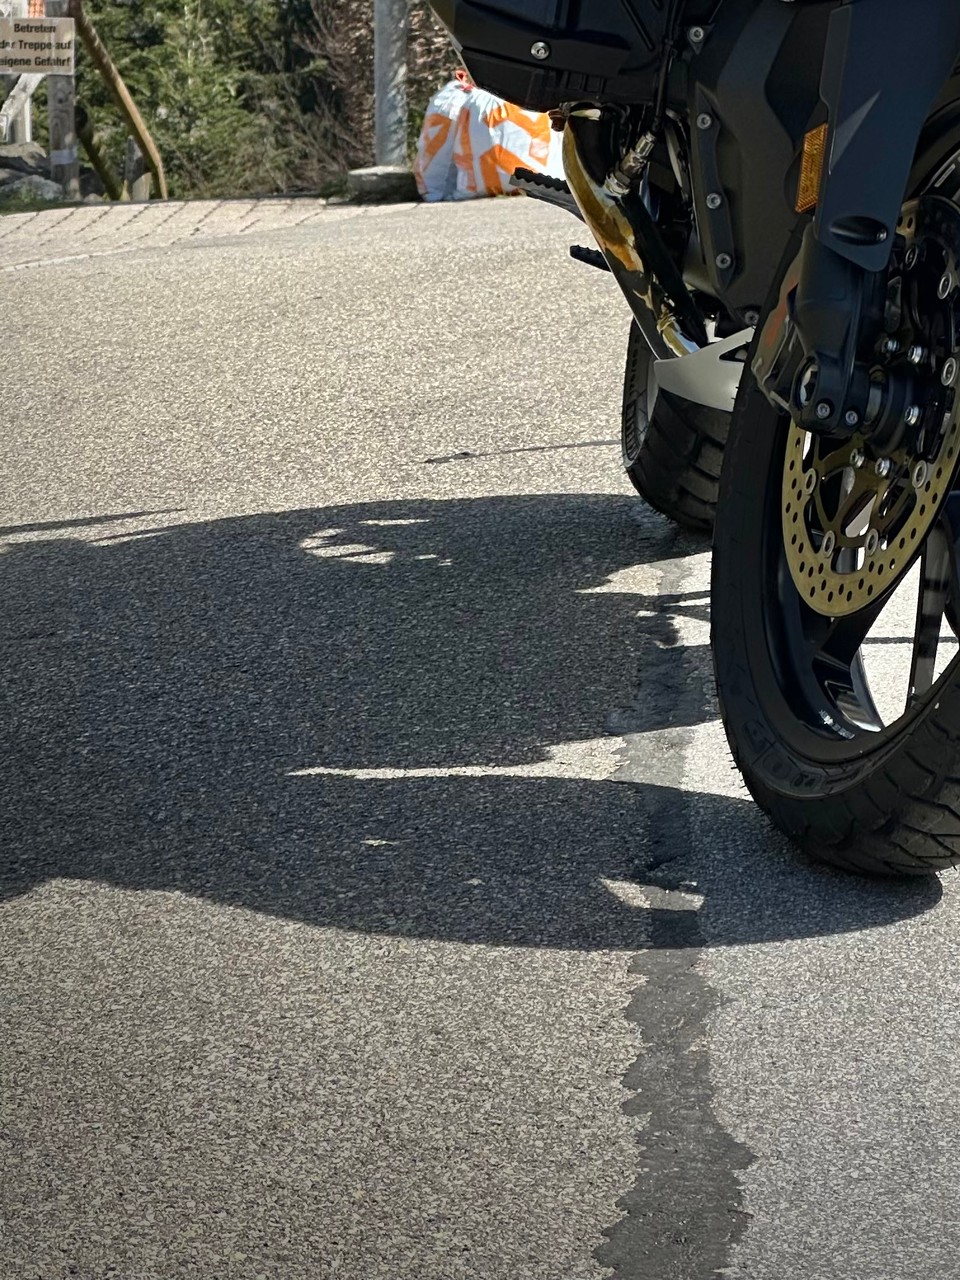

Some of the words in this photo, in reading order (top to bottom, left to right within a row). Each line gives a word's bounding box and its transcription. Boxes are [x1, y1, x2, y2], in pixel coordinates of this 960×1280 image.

[13, 23, 57, 33] Betreten
[18, 40, 52, 52] Treppe
[55, 40, 72, 50] auf
